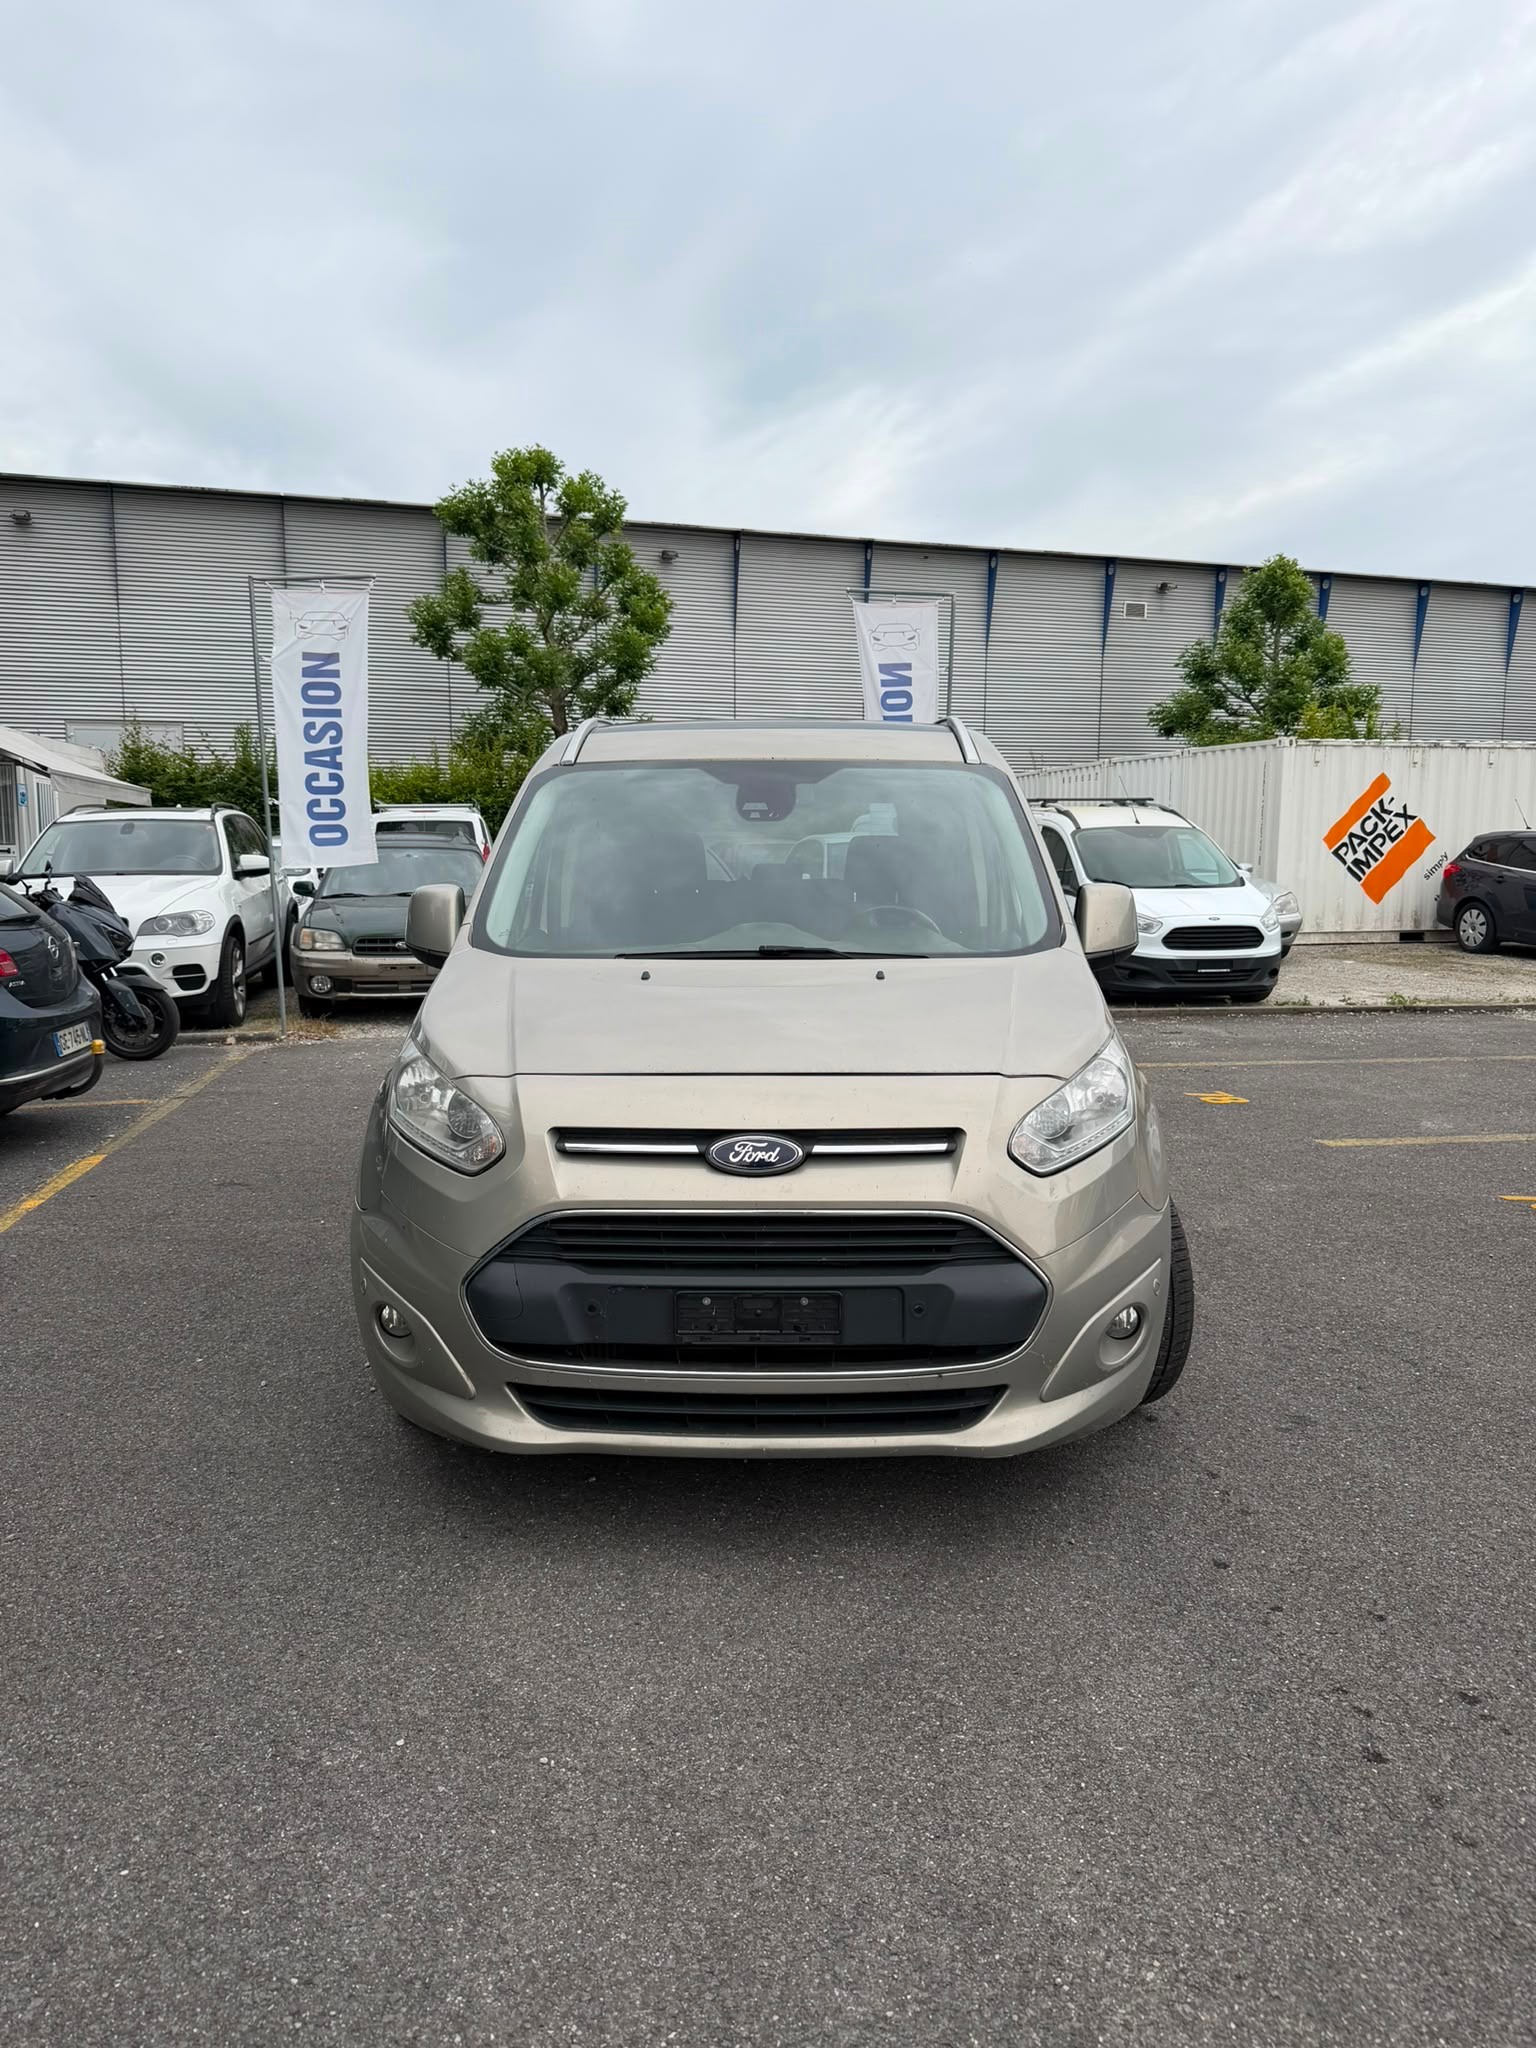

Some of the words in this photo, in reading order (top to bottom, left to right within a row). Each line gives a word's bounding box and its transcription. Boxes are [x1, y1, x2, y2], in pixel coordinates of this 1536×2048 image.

[301, 652, 349, 847] OCCASION
[1331, 797, 1395, 866] PACK-
[1346, 803, 1418, 882] IMPEX
[1424, 851, 1449, 880] simply
[729, 1141, 781, 1163] Ford
